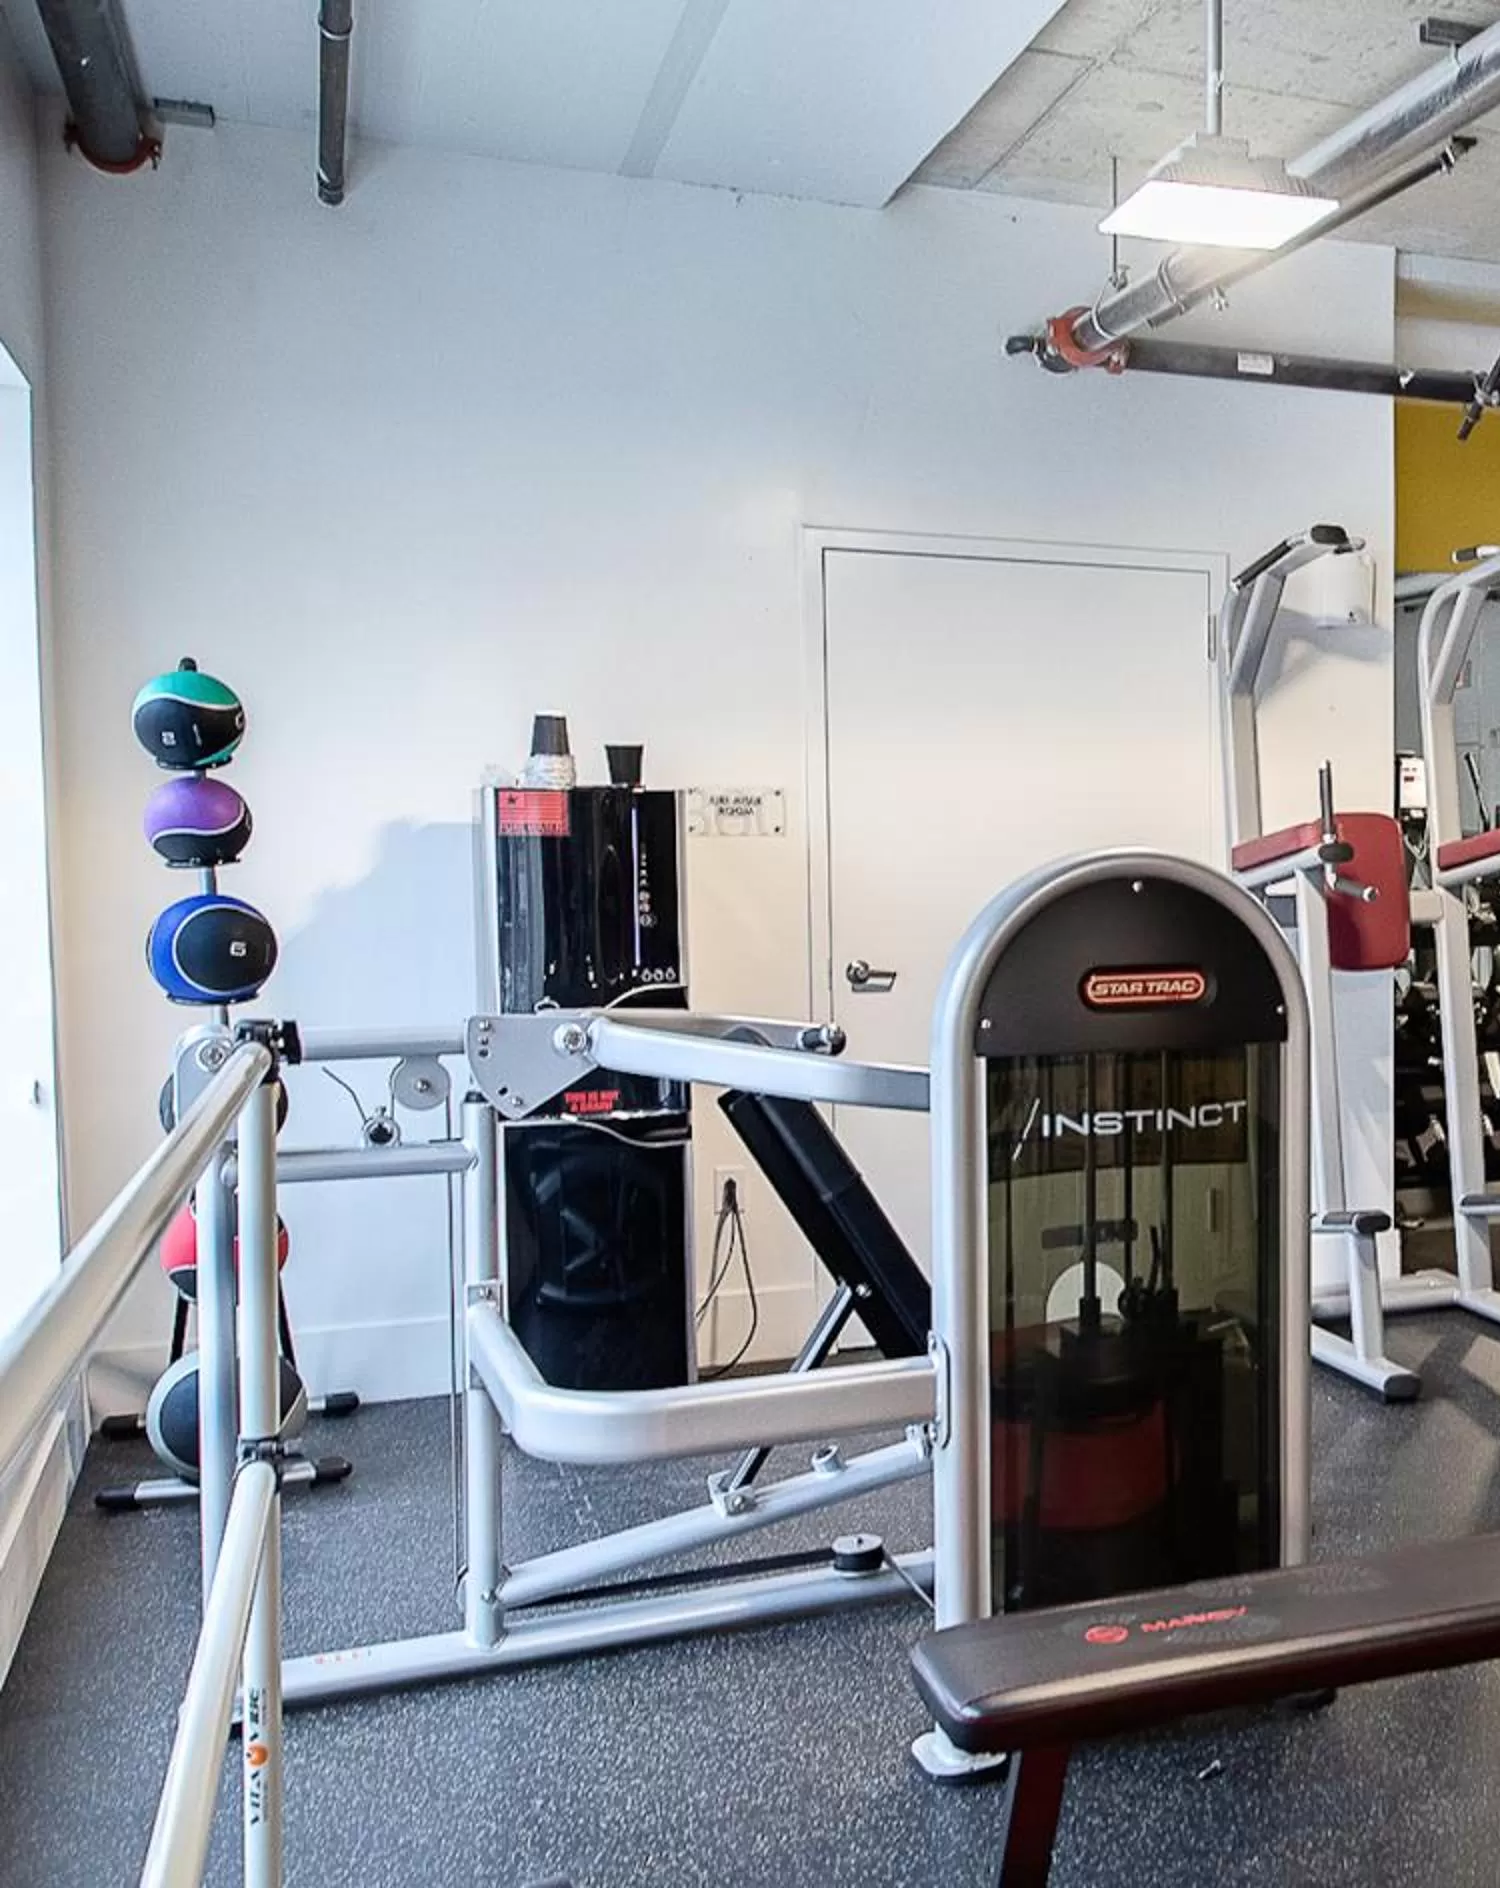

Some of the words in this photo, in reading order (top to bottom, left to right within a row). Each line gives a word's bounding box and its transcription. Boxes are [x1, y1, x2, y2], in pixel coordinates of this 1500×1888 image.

[1093, 982, 1143, 997] STAR
[1145, 980, 1196, 994] TRAC
[1041, 1100, 1247, 1138] INSTINCT
